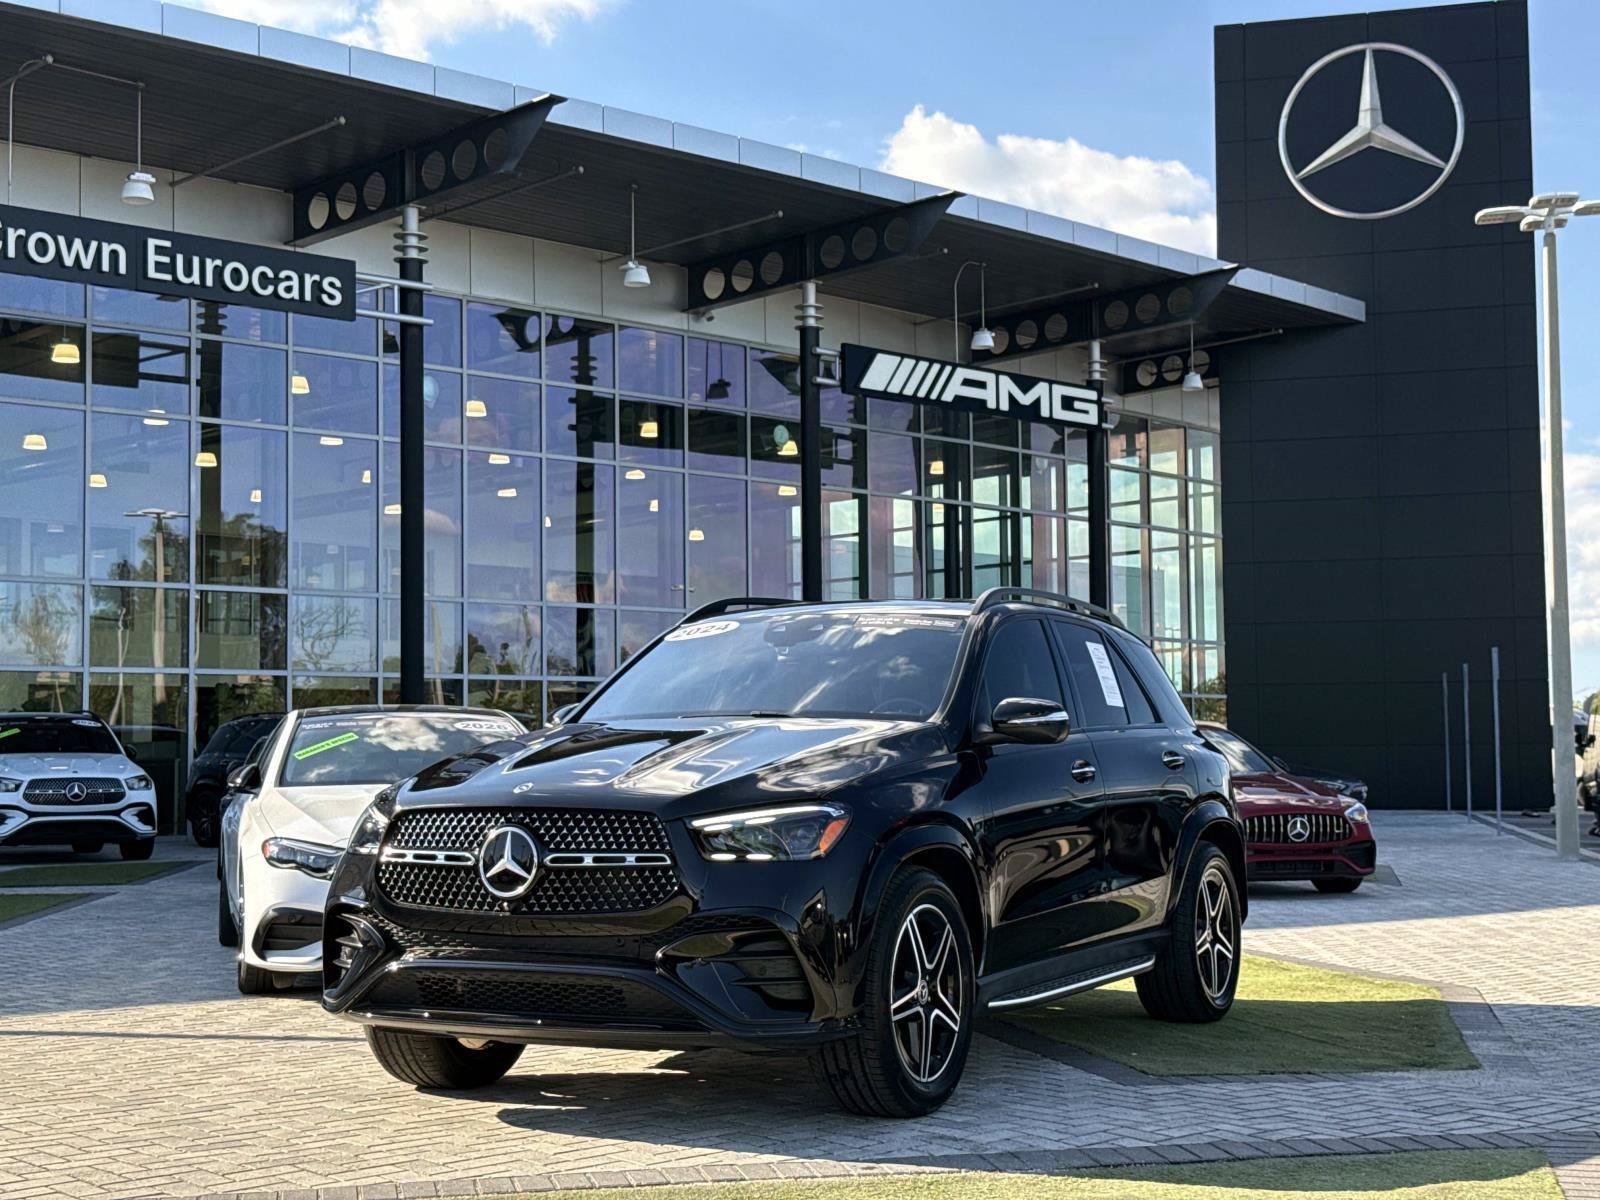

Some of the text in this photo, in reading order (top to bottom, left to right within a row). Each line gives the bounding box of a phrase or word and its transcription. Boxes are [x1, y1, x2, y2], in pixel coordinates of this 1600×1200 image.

[0, 219, 343, 306] rown Eurocars
[670, 622, 731, 639] 2024
